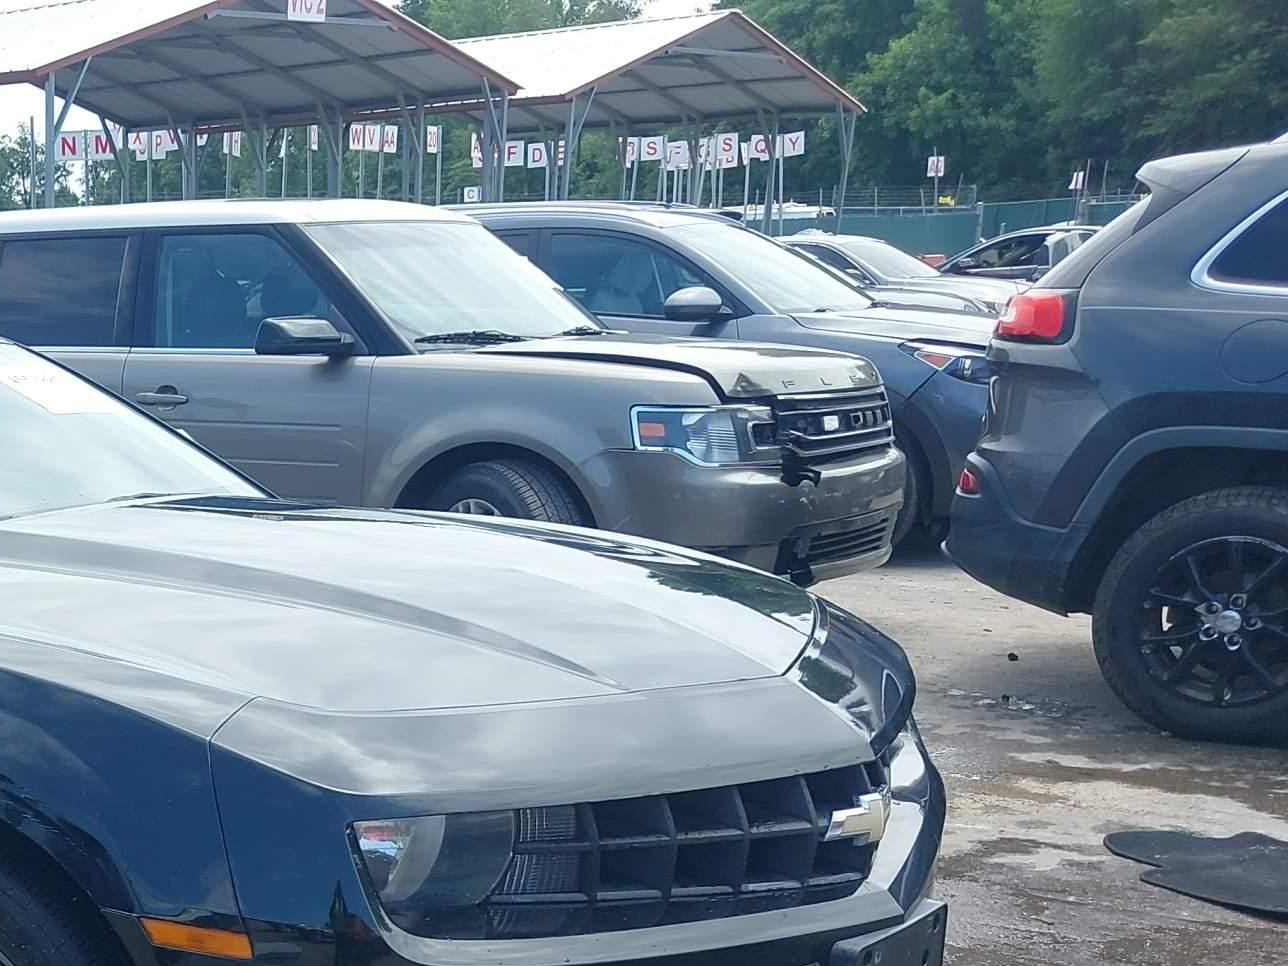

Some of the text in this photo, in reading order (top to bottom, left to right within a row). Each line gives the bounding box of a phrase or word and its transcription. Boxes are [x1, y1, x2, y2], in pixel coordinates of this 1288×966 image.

[95, 135, 112, 154] M
[155, 135, 162, 153] P
[352, 127, 362, 145] W
[368, 128, 375, 146] V
[722, 137, 733, 152] S
[788, 136, 799, 151] Y
[61, 136, 76, 156] N
[507, 145, 517, 162] F
[646, 141, 657, 156] S
[532, 147, 542, 163] D
